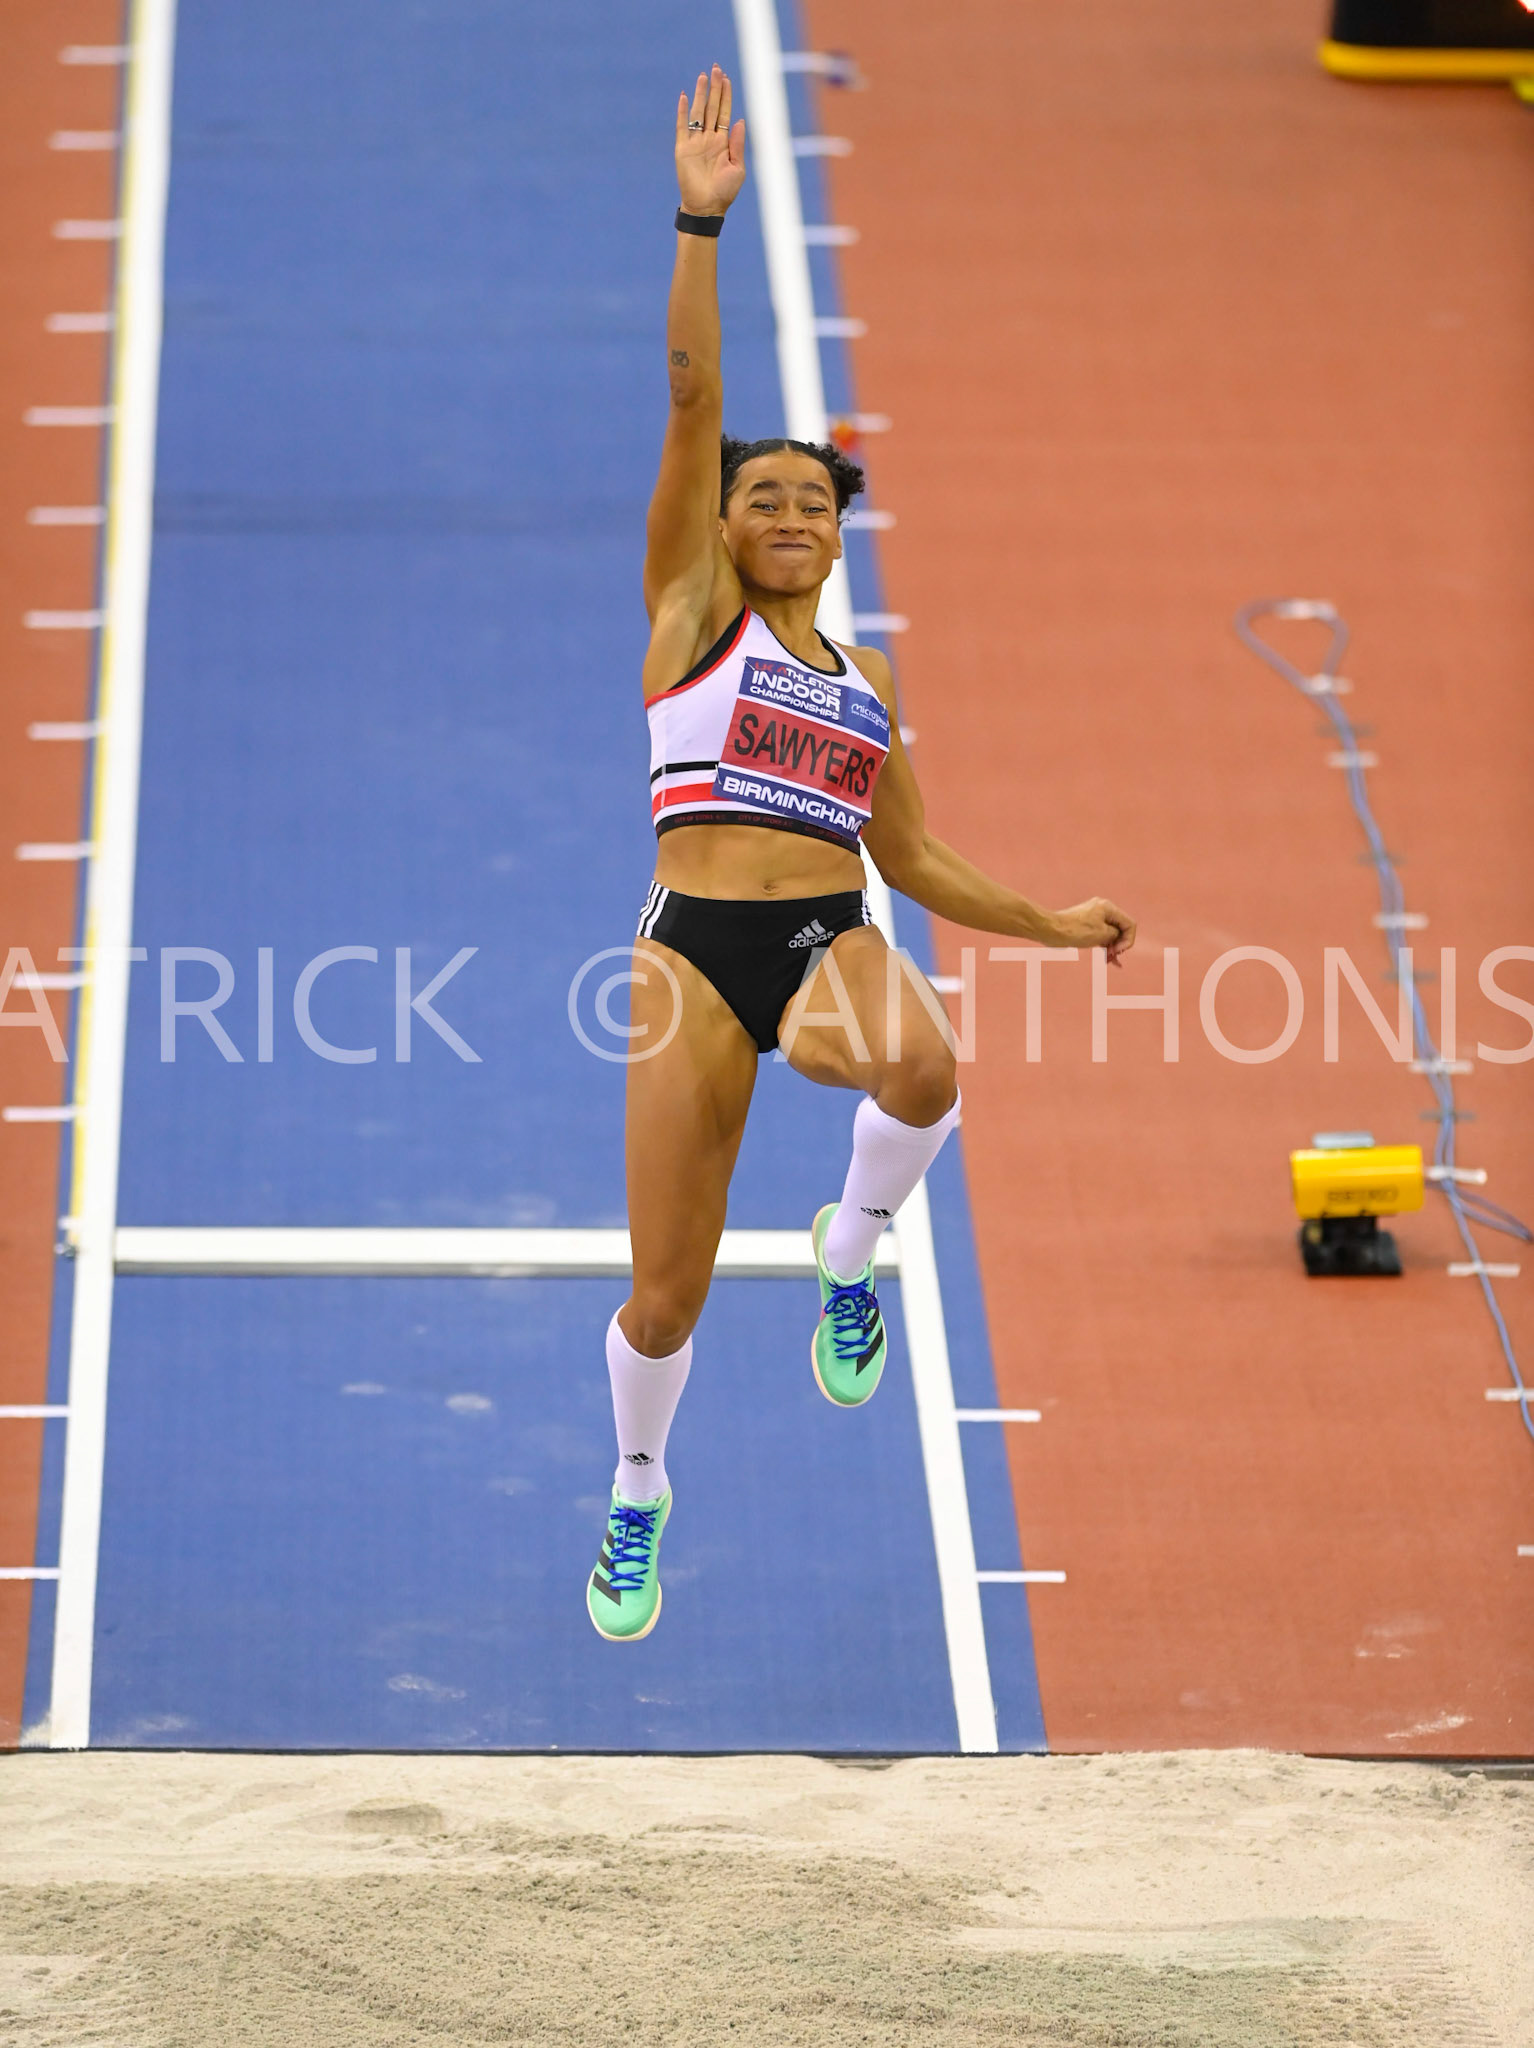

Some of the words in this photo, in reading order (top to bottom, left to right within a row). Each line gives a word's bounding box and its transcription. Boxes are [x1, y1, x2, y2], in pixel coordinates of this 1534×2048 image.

[751, 670, 841, 712] INDOOR
[755, 661, 774, 673] UK
[777, 666, 842, 697] ATHLETICS
[749, 685, 840, 721] CHAMPIONSHIPS
[734, 713, 876, 798] SAWYERS
[722, 776, 863, 834] BIRMINGHAM
[737, 814, 752, 822] CITY
[788, 930, 836, 949] adidas
